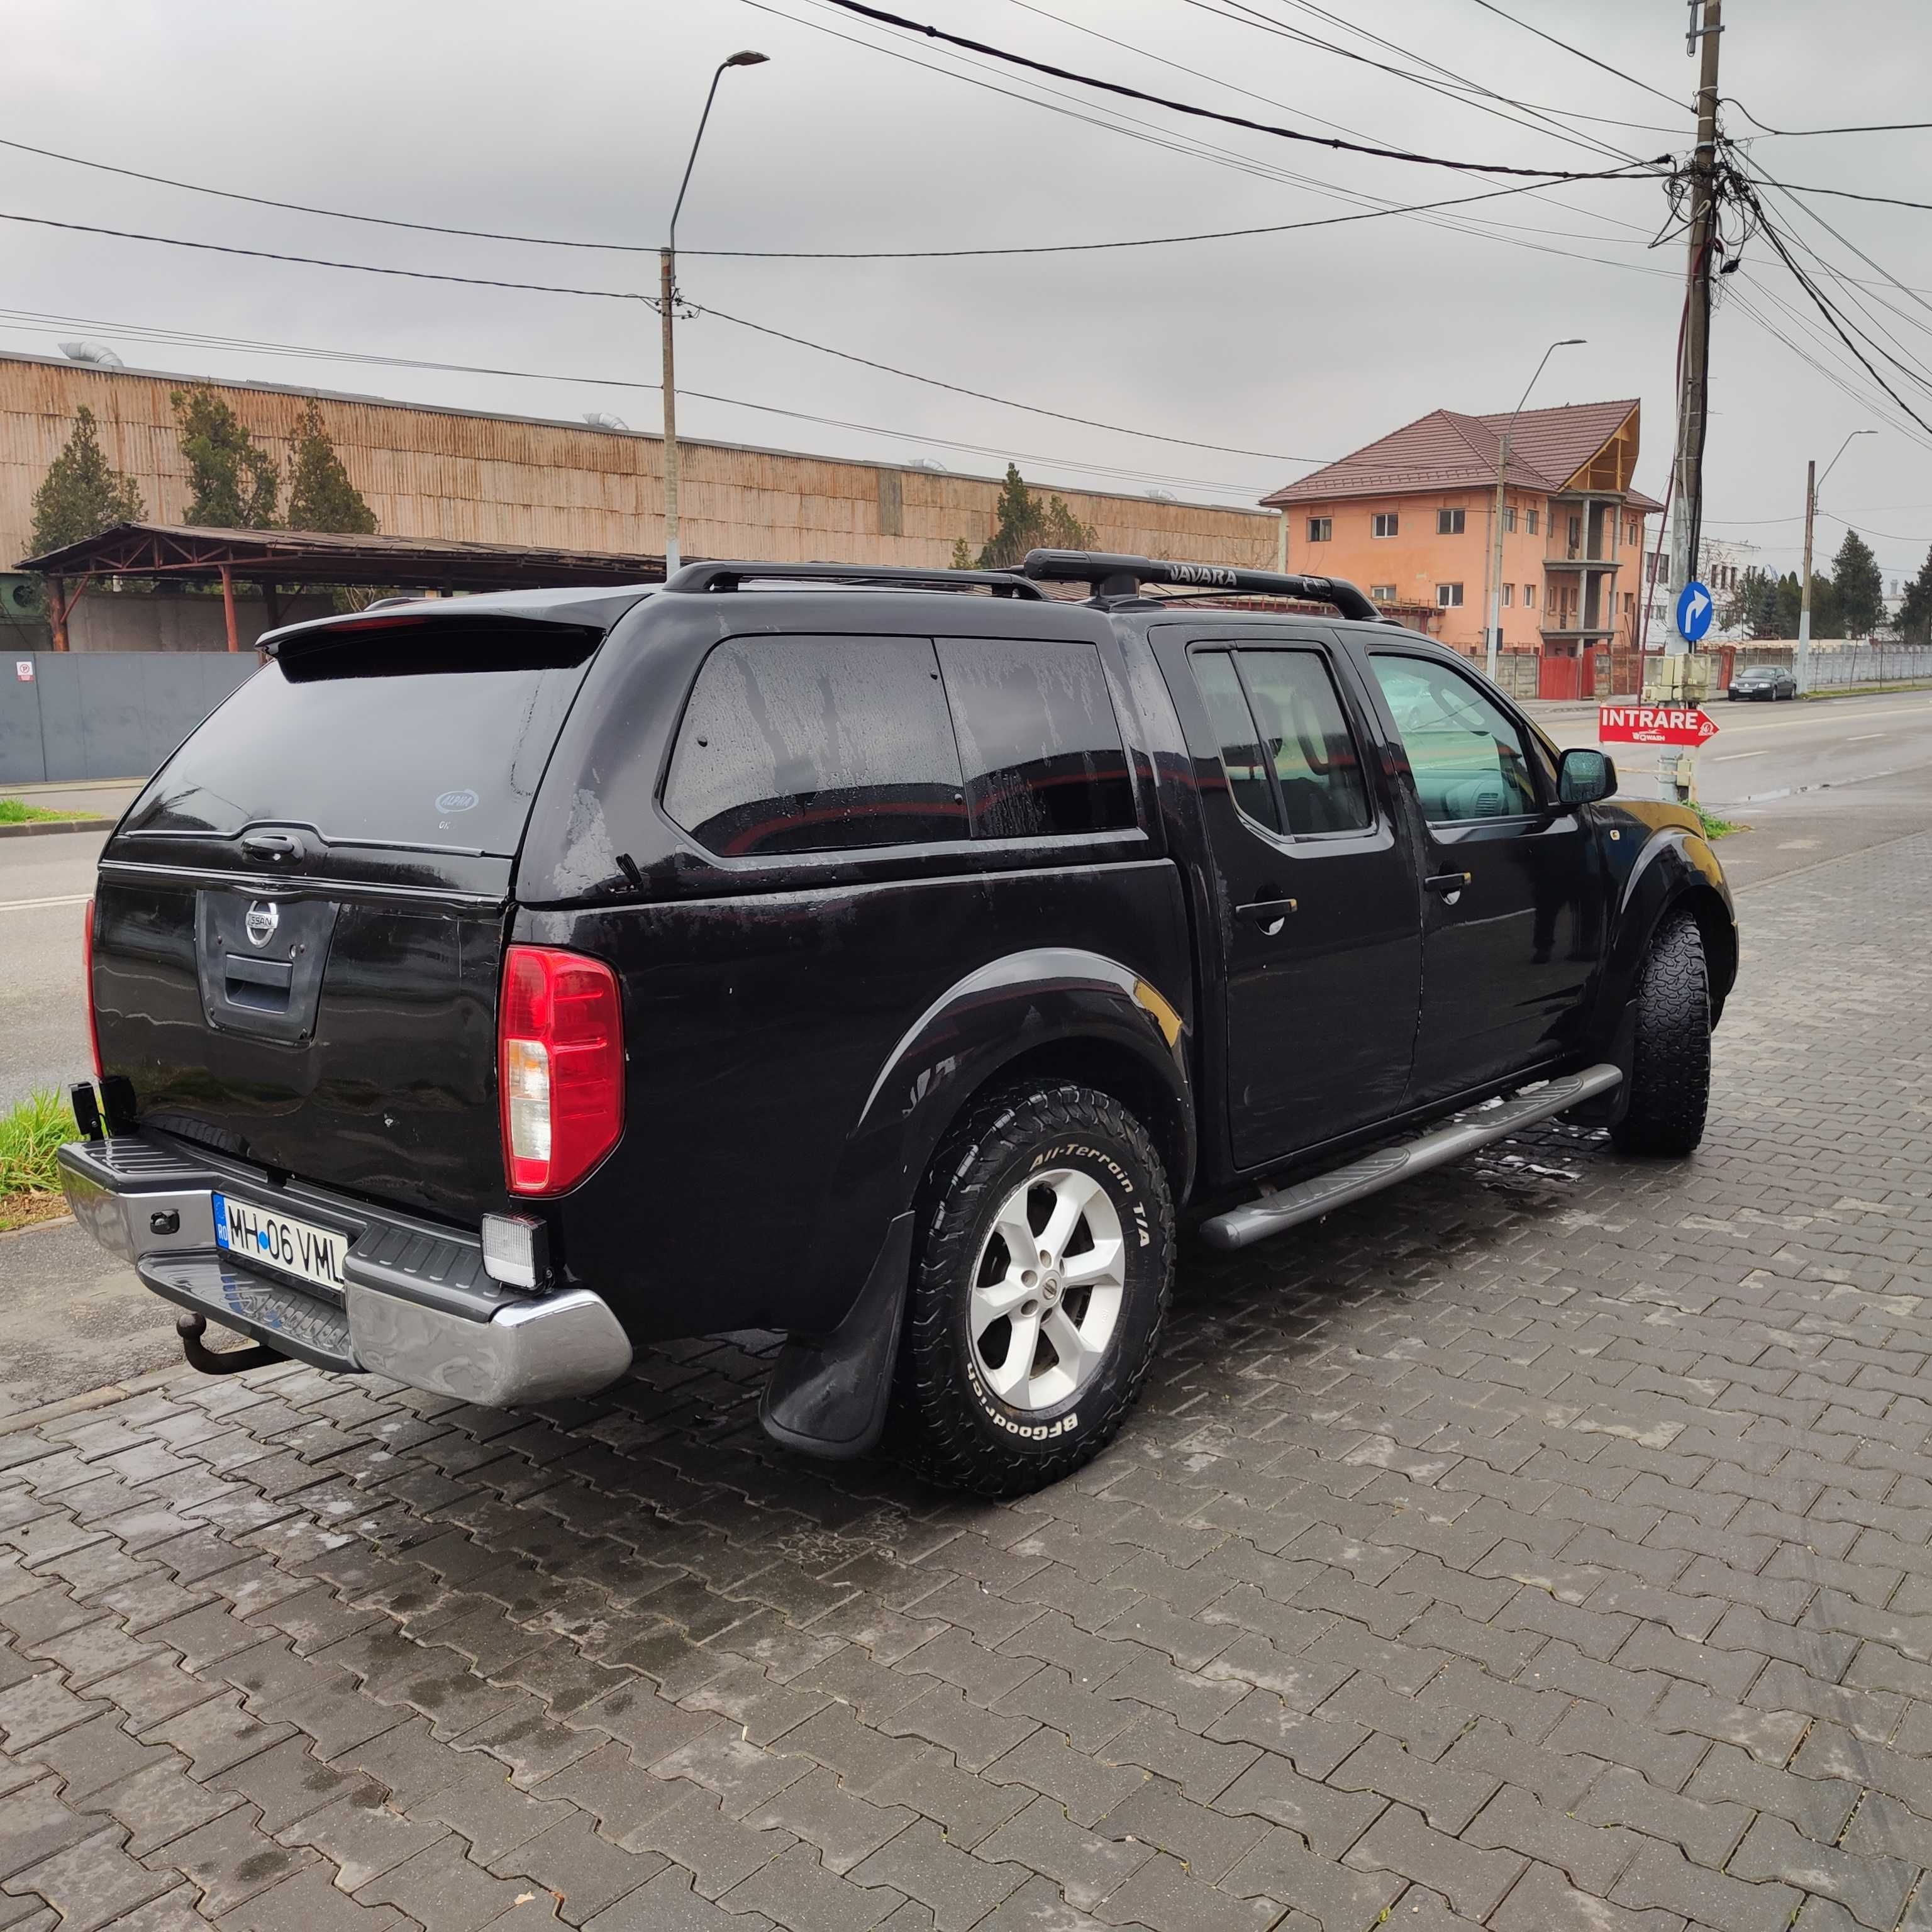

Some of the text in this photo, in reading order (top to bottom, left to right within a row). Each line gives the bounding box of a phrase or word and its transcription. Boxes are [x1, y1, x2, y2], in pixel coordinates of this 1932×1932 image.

[1602, 709, 1698, 730] INTRARE
[218, 1223, 228, 1241] RO
[1029, 1144, 1150, 1247] All-Terrain T/A
[228, 1205, 345, 1285] MH 06 VML
[967, 1362, 1079, 1441] BFGoodrich
